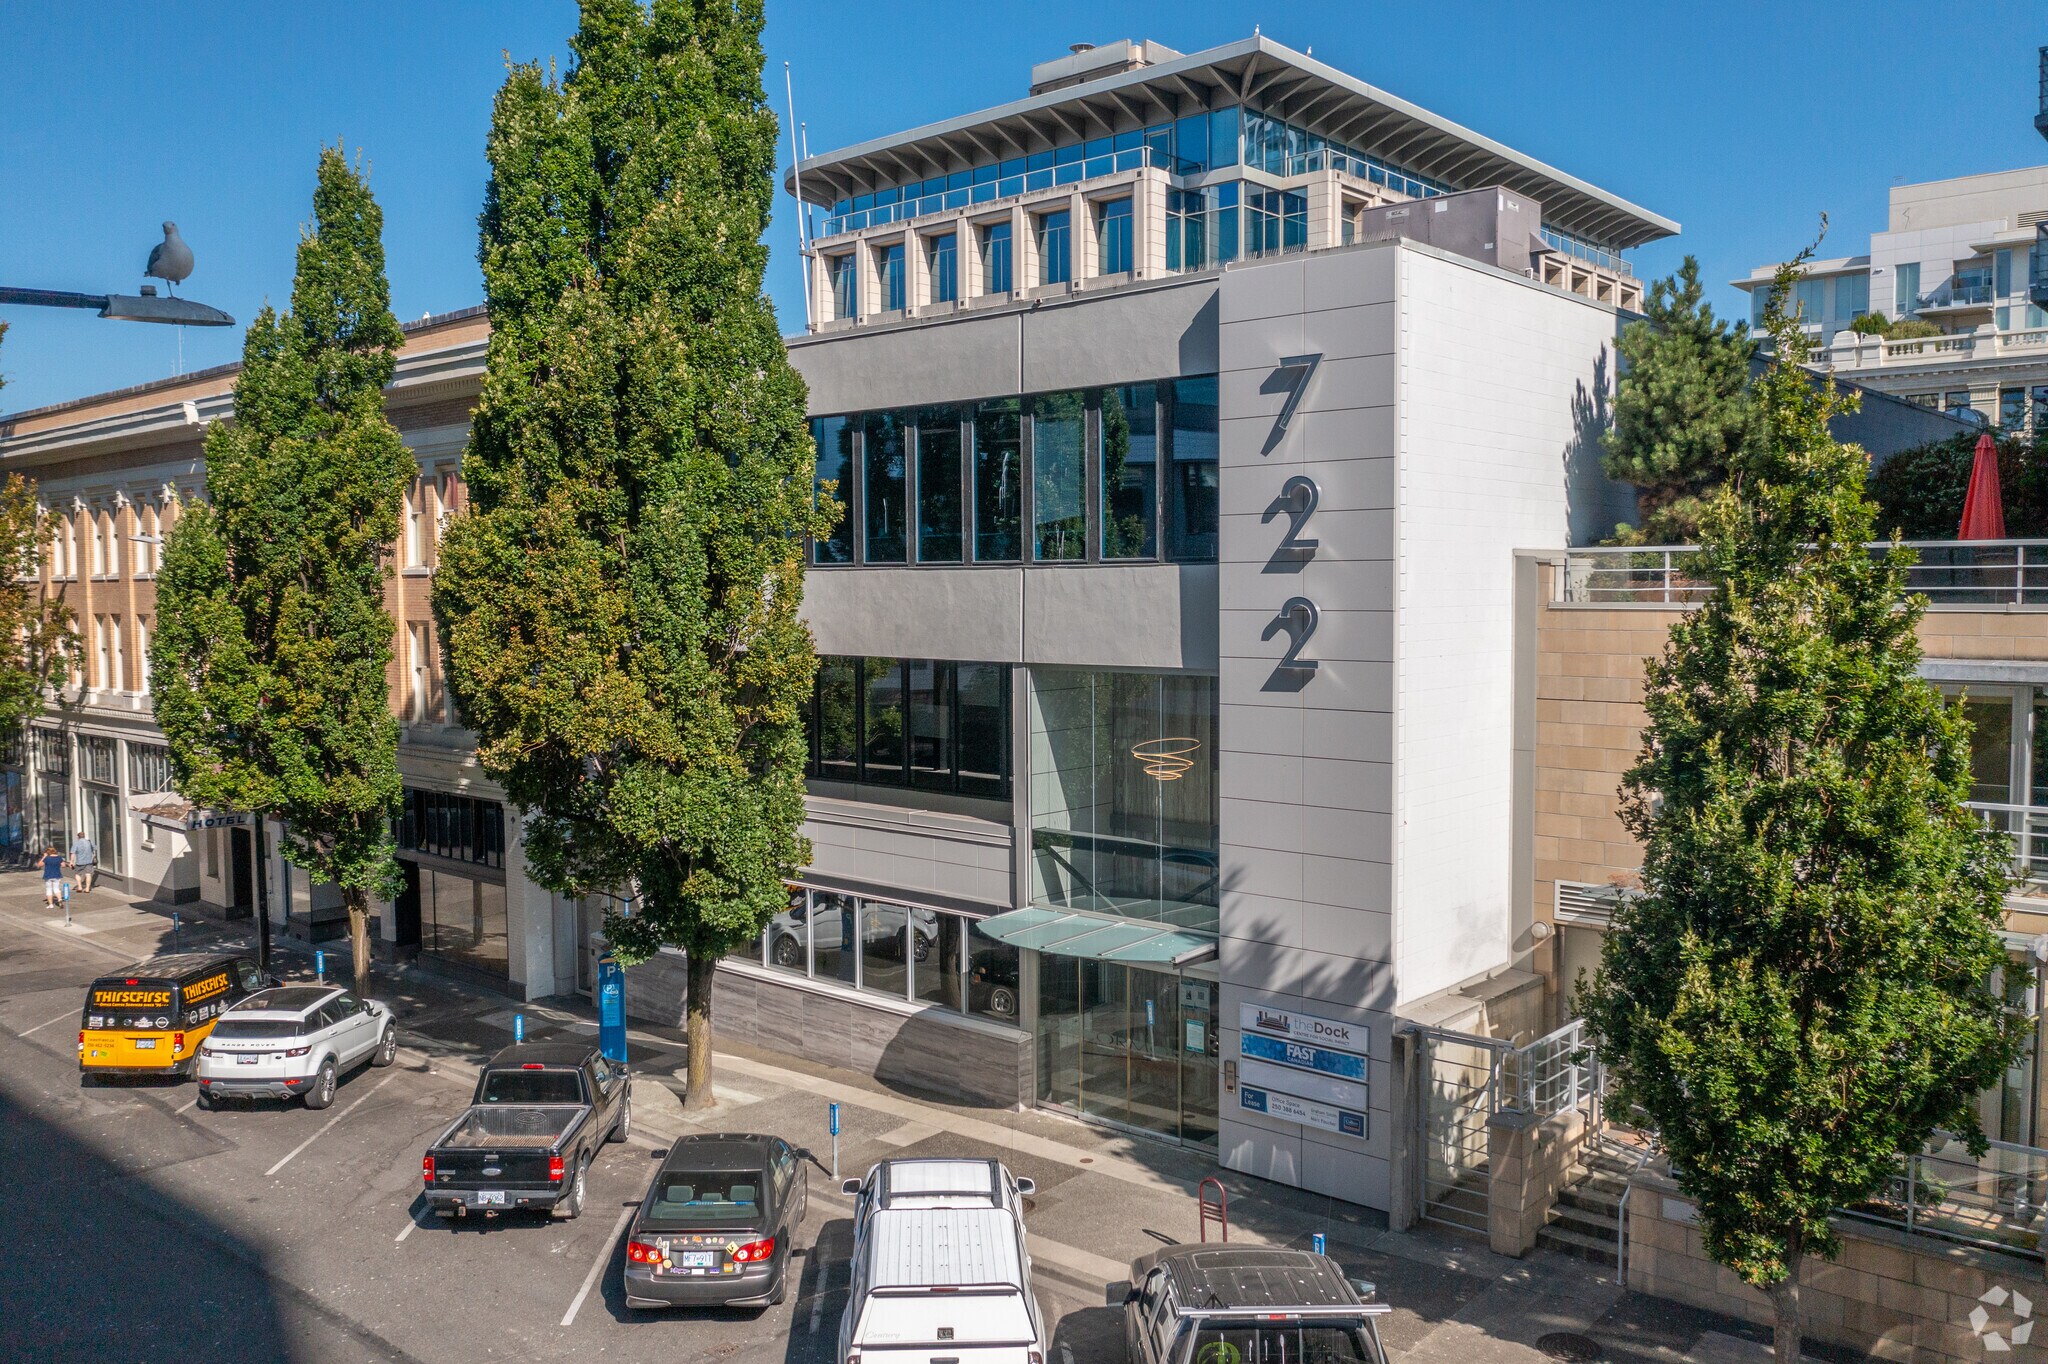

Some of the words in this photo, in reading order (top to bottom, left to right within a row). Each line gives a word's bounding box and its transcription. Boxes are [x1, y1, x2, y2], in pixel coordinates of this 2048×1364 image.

[192, 815, 245, 829] HOTEL
[607, 966, 616, 977] P
[1286, 1044, 1316, 1061] FAST
[1287, 1056, 1314, 1067] CANADIAN
[1244, 1091, 1254, 1099] For
[1244, 1097, 1260, 1107] Lease
[1271, 1096, 1285, 1104] Office
[1286, 1099, 1300, 1108] Space
[1271, 1103, 1282, 1111] 250
